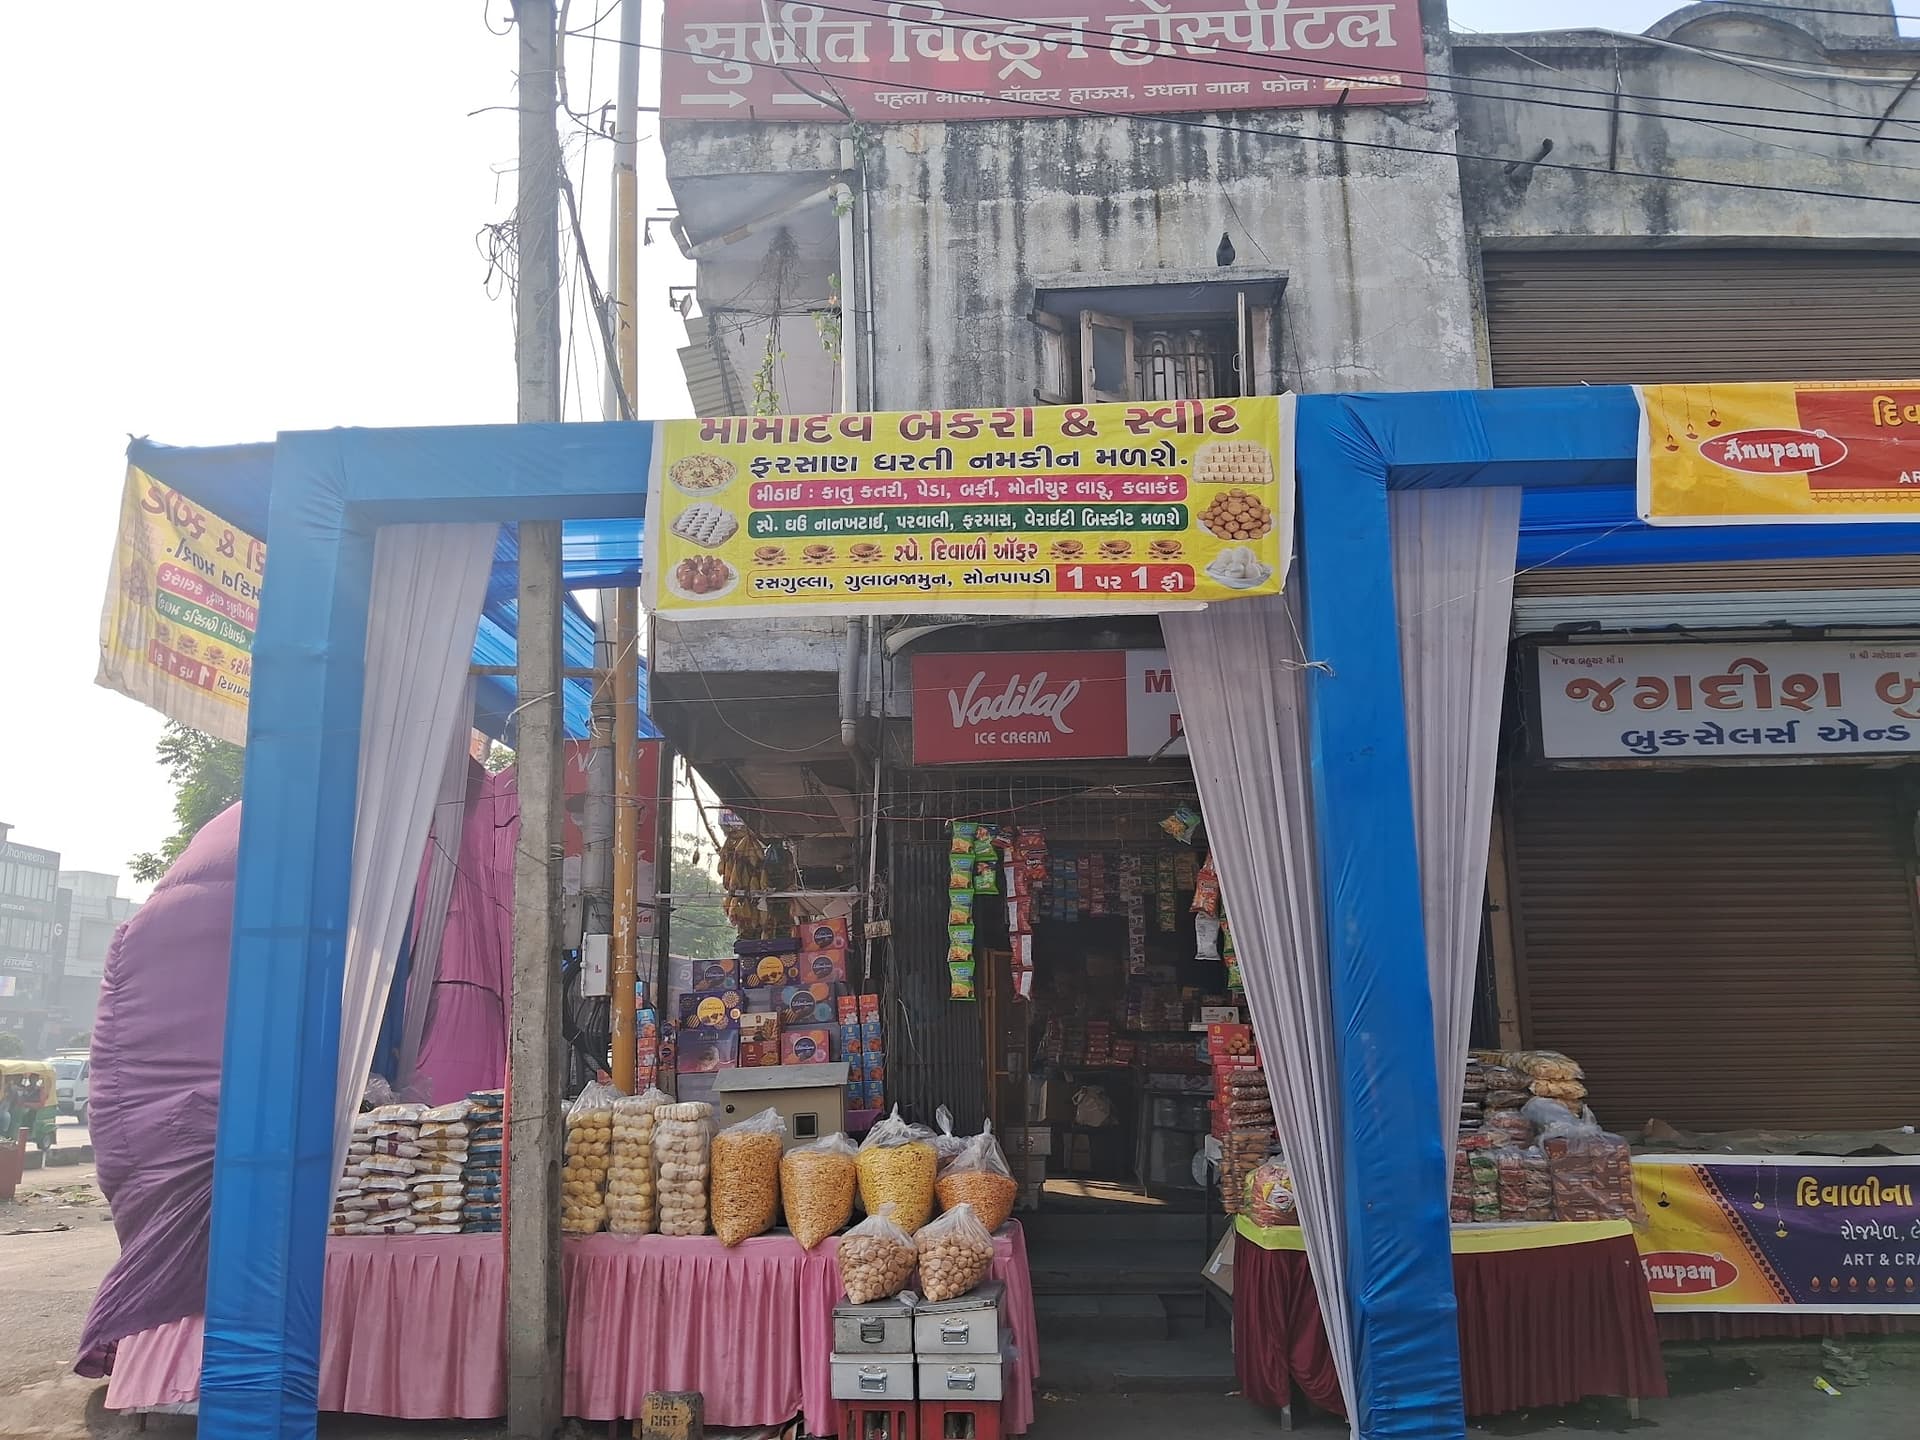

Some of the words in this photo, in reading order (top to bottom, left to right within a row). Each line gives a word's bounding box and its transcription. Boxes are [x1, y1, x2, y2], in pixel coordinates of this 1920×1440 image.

[684, 2, 872, 85] सुमीत
[873, 90, 928, 109] पहला
[1144, 83, 1197, 98] उधना
[1205, 82, 1249, 95] गाम
[1060, 407, 1098, 437] &
[1124, 399, 1240, 435] સ્વીટ
[750, 455, 859, 479] ફરસાણ
[969, 445, 1079, 470] નમકીન
[1096, 440, 1188, 467] મળશે.
[1723, 438, 1823, 467] Anupam
[757, 485, 802, 501] મીઠાઈ
[860, 482, 908, 500] કતરી,
[917, 479, 951, 499] પેડા,
[1122, 476, 1179, 495] કલાકંદ
[814, 511, 889, 532] નાનખટાઈ,
[896, 510, 954, 531] પરવાલી,
[962, 511, 1017, 529] ફરમાસ,
[1081, 507, 1134, 527] બિસ્કીટ
[1140, 507, 1180, 526] મળશે
[930, 536, 986, 562] દિવાળી
[755, 575, 834, 593] રસગુલ્લા,
[844, 571, 953, 591] ગુલાબજામુન,
[963, 568, 1050, 585] સોનપાપડી
[1066, 566, 1084, 590] 1
[1095, 574, 1122, 590] પર
[1130, 566, 1149, 590] 1
[1160, 571, 1184, 592] ફ્રી
[1565, 657, 1843, 712] જગદીશ
[948, 671, 1081, 734] Vadilal
[974, 732, 996, 744] ICE
[1000, 731, 1051, 745] CREAM
[1621, 719, 1801, 754] બુકસેલર્સ
[1818, 719, 1911, 742] એન્ડ
[1796, 1176, 1912, 1207] દિવાળીના
[1841, 1219, 1904, 1242] રોજમેળ,
[1843, 1253, 1874, 1266] ART
[1879, 1253, 1890, 1266] &
